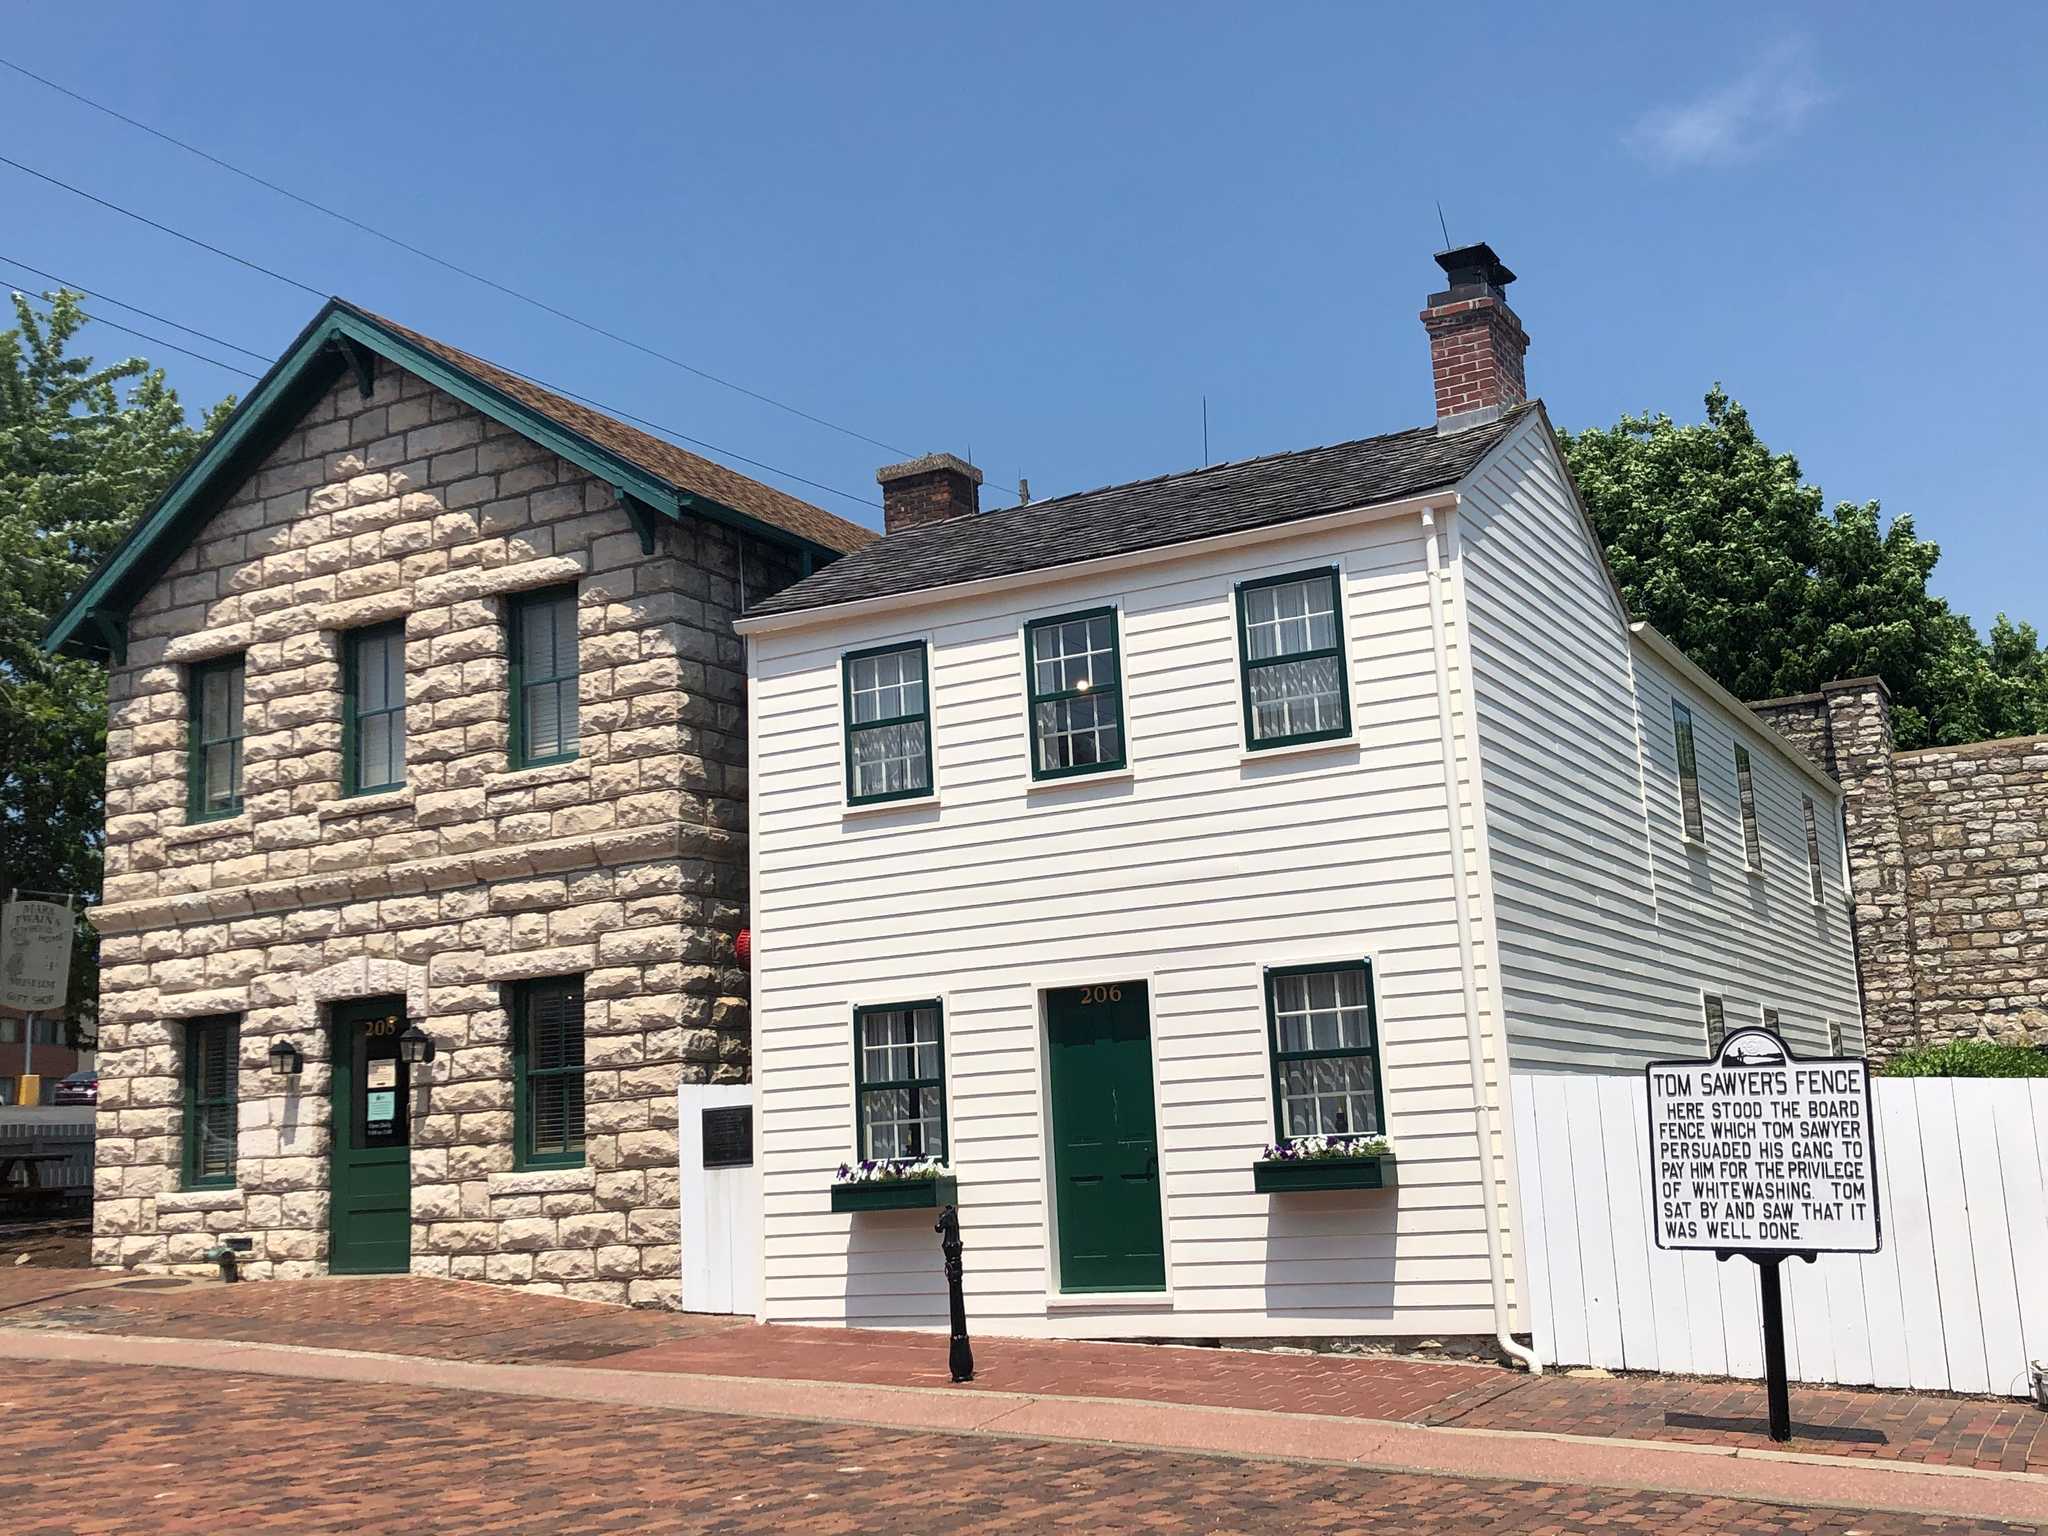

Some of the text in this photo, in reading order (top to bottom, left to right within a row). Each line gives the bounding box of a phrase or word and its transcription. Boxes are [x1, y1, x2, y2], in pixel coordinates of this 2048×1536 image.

[1080, 984, 1121, 1004] 206
[1654, 1070, 1860, 1097] TOM SAWYER'S FENCE
[1667, 1100, 1858, 1119] HERE STOOD THE BOARD
[1660, 1121, 1860, 1139] FENCE WHICH TOM SAWYER
[1661, 1141, 1862, 1159] PERSUADED HIS GANG TO
[1662, 1162, 1864, 1179] PAY HIM FOR THE PRIVILEGE
[1663, 1182, 1865, 1199] OF WHITEWASHING. TOM
[1665, 1202, 1866, 1220] SAT BY AND SAW THAT IT
[1666, 1222, 1802, 1240] WAS WELL DONE.
